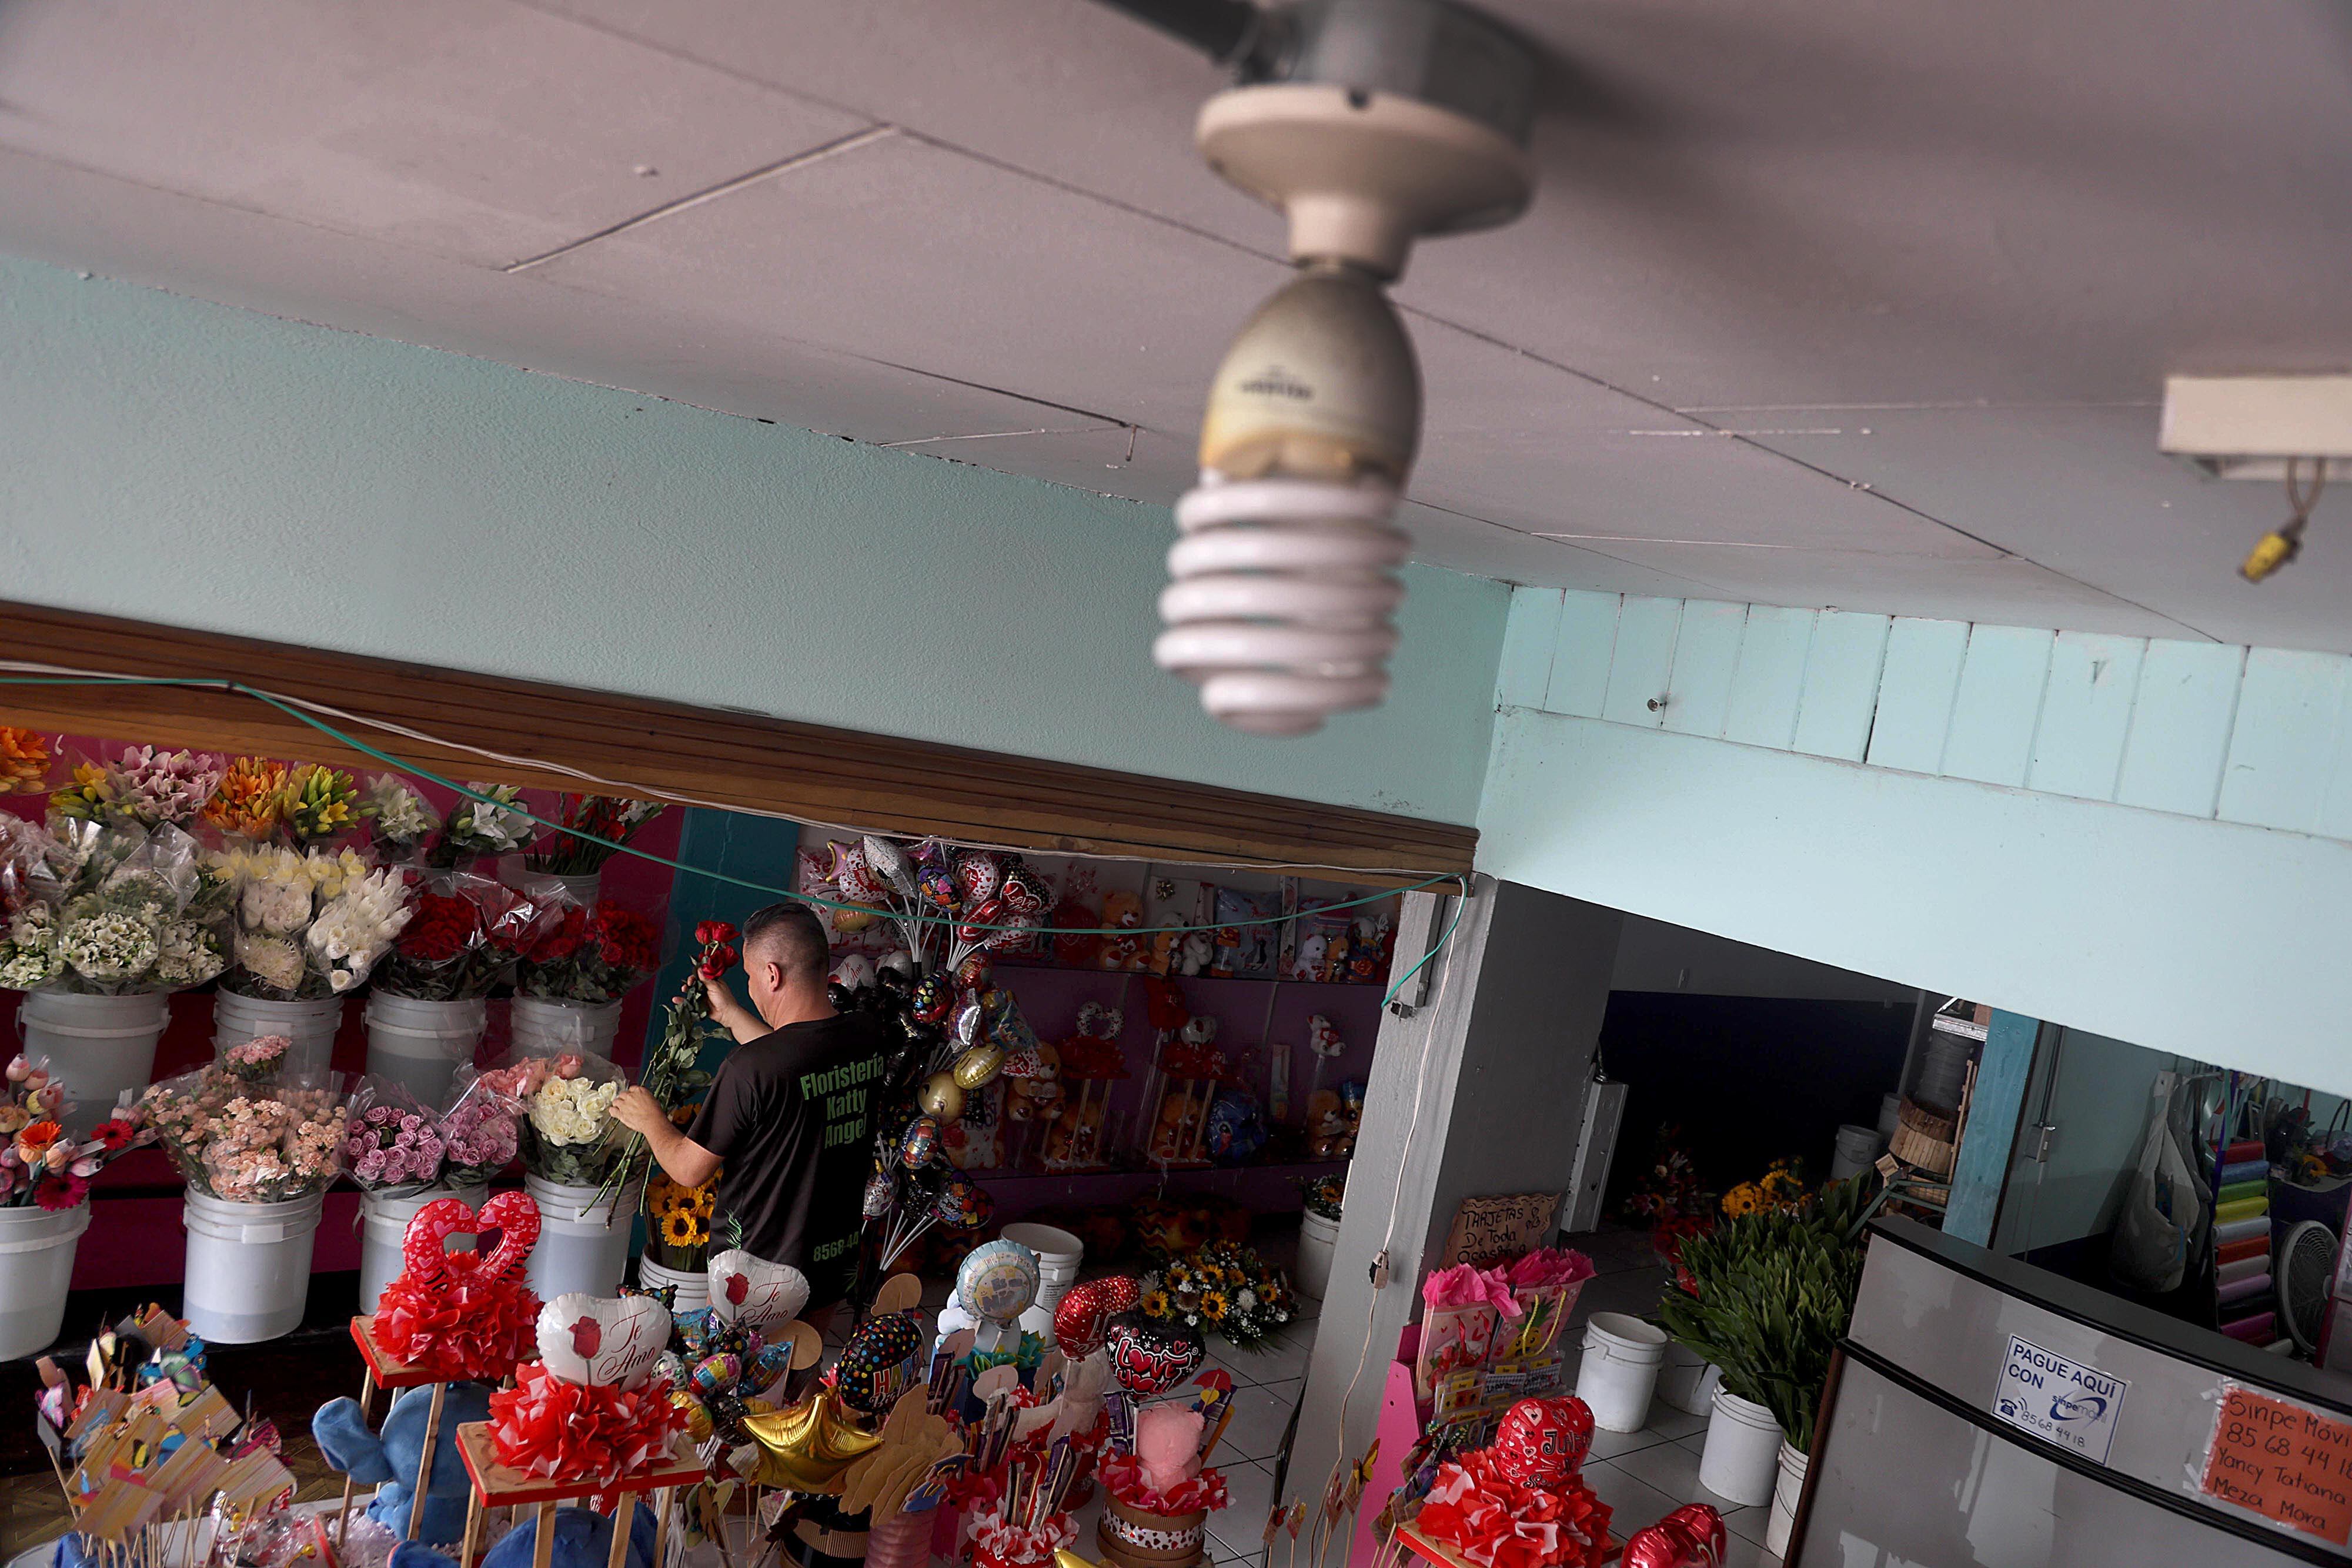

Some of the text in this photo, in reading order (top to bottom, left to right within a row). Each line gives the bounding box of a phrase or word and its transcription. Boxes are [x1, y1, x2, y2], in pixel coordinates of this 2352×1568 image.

[800, 1051, 884, 1101] Floristería
[826, 1088, 867, 1121] Katty
[824, 1112, 867, 1149] Angel
[1462, 1208, 1524, 1229] TARJETAS
[1461, 1233, 1484, 1248] De
[753, 1279, 792, 1308] Te
[609, 1308, 650, 1353] Te
[740, 1304, 789, 1324] Amo
[597, 1344, 655, 1382] Amo
[2009, 1364, 2044, 1389] CON
[2013, 1344, 2117, 1399] PAGUE AQUÍ
[2229, 1394, 2297, 1430] Sinpe
[2227, 1422, 2257, 1447] 85
[2265, 1435, 2290, 1457] 68
[2219, 1446, 2346, 1505] Yancy Tatiana
[2214, 1476, 2326, 1530] Meza Mora
